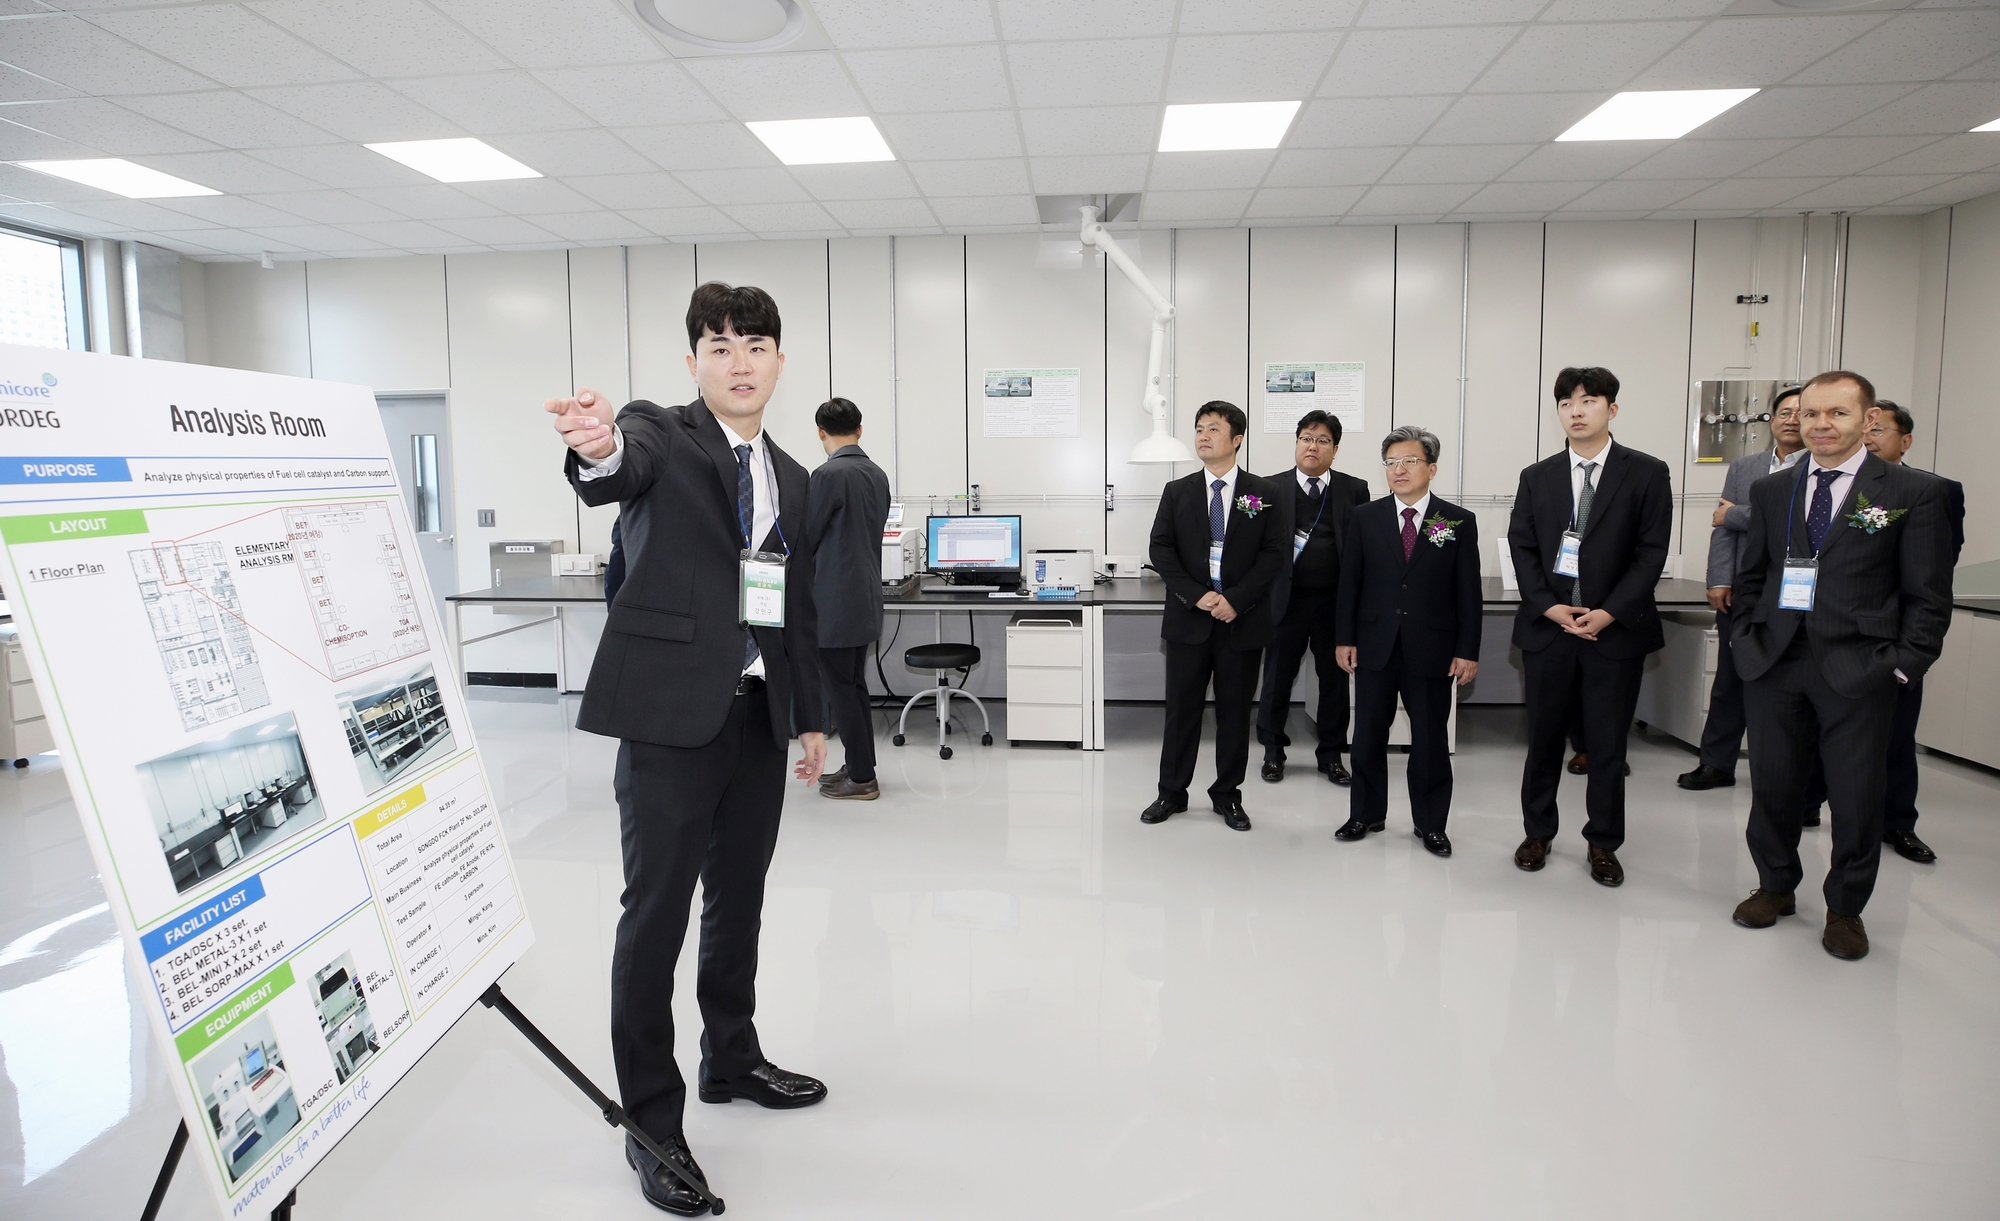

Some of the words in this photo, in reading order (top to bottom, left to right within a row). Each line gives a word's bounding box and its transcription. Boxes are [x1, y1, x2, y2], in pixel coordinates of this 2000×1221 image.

[170, 404, 266, 437] Analysis
[270, 410, 327, 438] Room
[22, 463, 98, 478] PURPOSE
[144, 472, 183, 483] Analyze
[185, 471, 222, 483] physical
[225, 471, 266, 482] properties
[268, 470, 276, 479] of
[276, 470, 293, 479] Fuel
[293, 470, 306, 478] cell
[307, 469, 333, 480] catalyst
[333, 469, 345, 478] and
[345, 469, 368, 478] Carbon
[49, 518, 107, 534] LAYOUT
[295, 521, 308, 530] BET
[235, 540, 291, 556] ELEMENTARY
[304, 550, 316, 559] BET
[29, 569, 36, 580] 1
[40, 566, 74, 579] Floor
[77, 563, 105, 575] Plan
[240, 555, 281, 569] ANALYSIS
[282, 553, 295, 564] RM
[312, 576, 324, 585] BET
[319, 599, 331, 608] BET
[399, 618, 410, 627] TGA
[325, 629, 368, 647] CHEMISOPTION
[376, 799, 408, 824] DETAILS
[376, 838, 390, 852] Total
[390, 832, 403, 844] Area
[417, 835, 439, 854] SONGDO
[438, 828, 449, 840] FCK
[448, 821, 461, 834] Plant
[423, 856, 442, 872] Analyze
[441, 842, 460, 860] physical
[459, 830, 480, 848] properties
[484, 818, 493, 830] Fuel
[450, 853, 459, 864] cell
[458, 842, 476, 858] catalyst
[385, 857, 409, 875] Location
[434, 882, 442, 892] FE
[459, 864, 466, 873] FE
[480, 848, 486, 858] FE
[459, 865, 479, 883] CARBON
[386, 892, 400, 904] Main
[398, 876, 423, 896] Business
[467, 883, 484, 900] persons
[164, 905, 221, 946] FACILITY
[221, 889, 248, 913] LIST
[396, 914, 409, 926] Test
[408, 900, 427, 918] Sample
[482, 901, 494, 913] Kang
[406, 927, 428, 949] Operator
[488, 924, 497, 934] Kim
[154, 968, 166, 979] 1.
[167, 937, 218, 971] TGA/DSC
[216, 934, 224, 944] X
[224, 927, 231, 937] 3
[159, 984, 170, 994] 2.
[172, 967, 194, 986] BEL
[194, 938, 238, 972] METAL-3
[238, 933, 246, 943] X
[247, 928, 252, 938] 1
[253, 920, 268, 935] set
[410, 966, 417, 976] IN
[416, 947, 439, 970] CHARGE
[164, 997, 175, 1008] 3.
[177, 966, 222, 999] BEL-MINI
[224, 960, 231, 970] X
[232, 955, 240, 965] X
[240, 949, 248, 960] 2
[248, 939, 263, 954] set
[170, 1012, 180, 1022] 4.
[181, 995, 204, 1014] BEL
[204, 960, 256, 999] SORP-MAX
[256, 955, 264, 965] X
[264, 950, 270, 960] 1
[270, 939, 285, 954] set
[366, 970, 380, 984] BEL
[369, 969, 395, 994] METAL-3
[416, 989, 424, 1000] IN
[423, 970, 446, 994] CHARGE
[204, 981, 273, 1039] EQUIPMENT
[382, 1010, 410, 1039] BELSORP
[301, 1079, 335, 1113] TGA/DSC
[232, 1151, 295, 1218] materials
[296, 1136, 311, 1160] for
[312, 1128, 320, 1141] a
[320, 1098, 354, 1132] better
[353, 1074, 372, 1100] life
